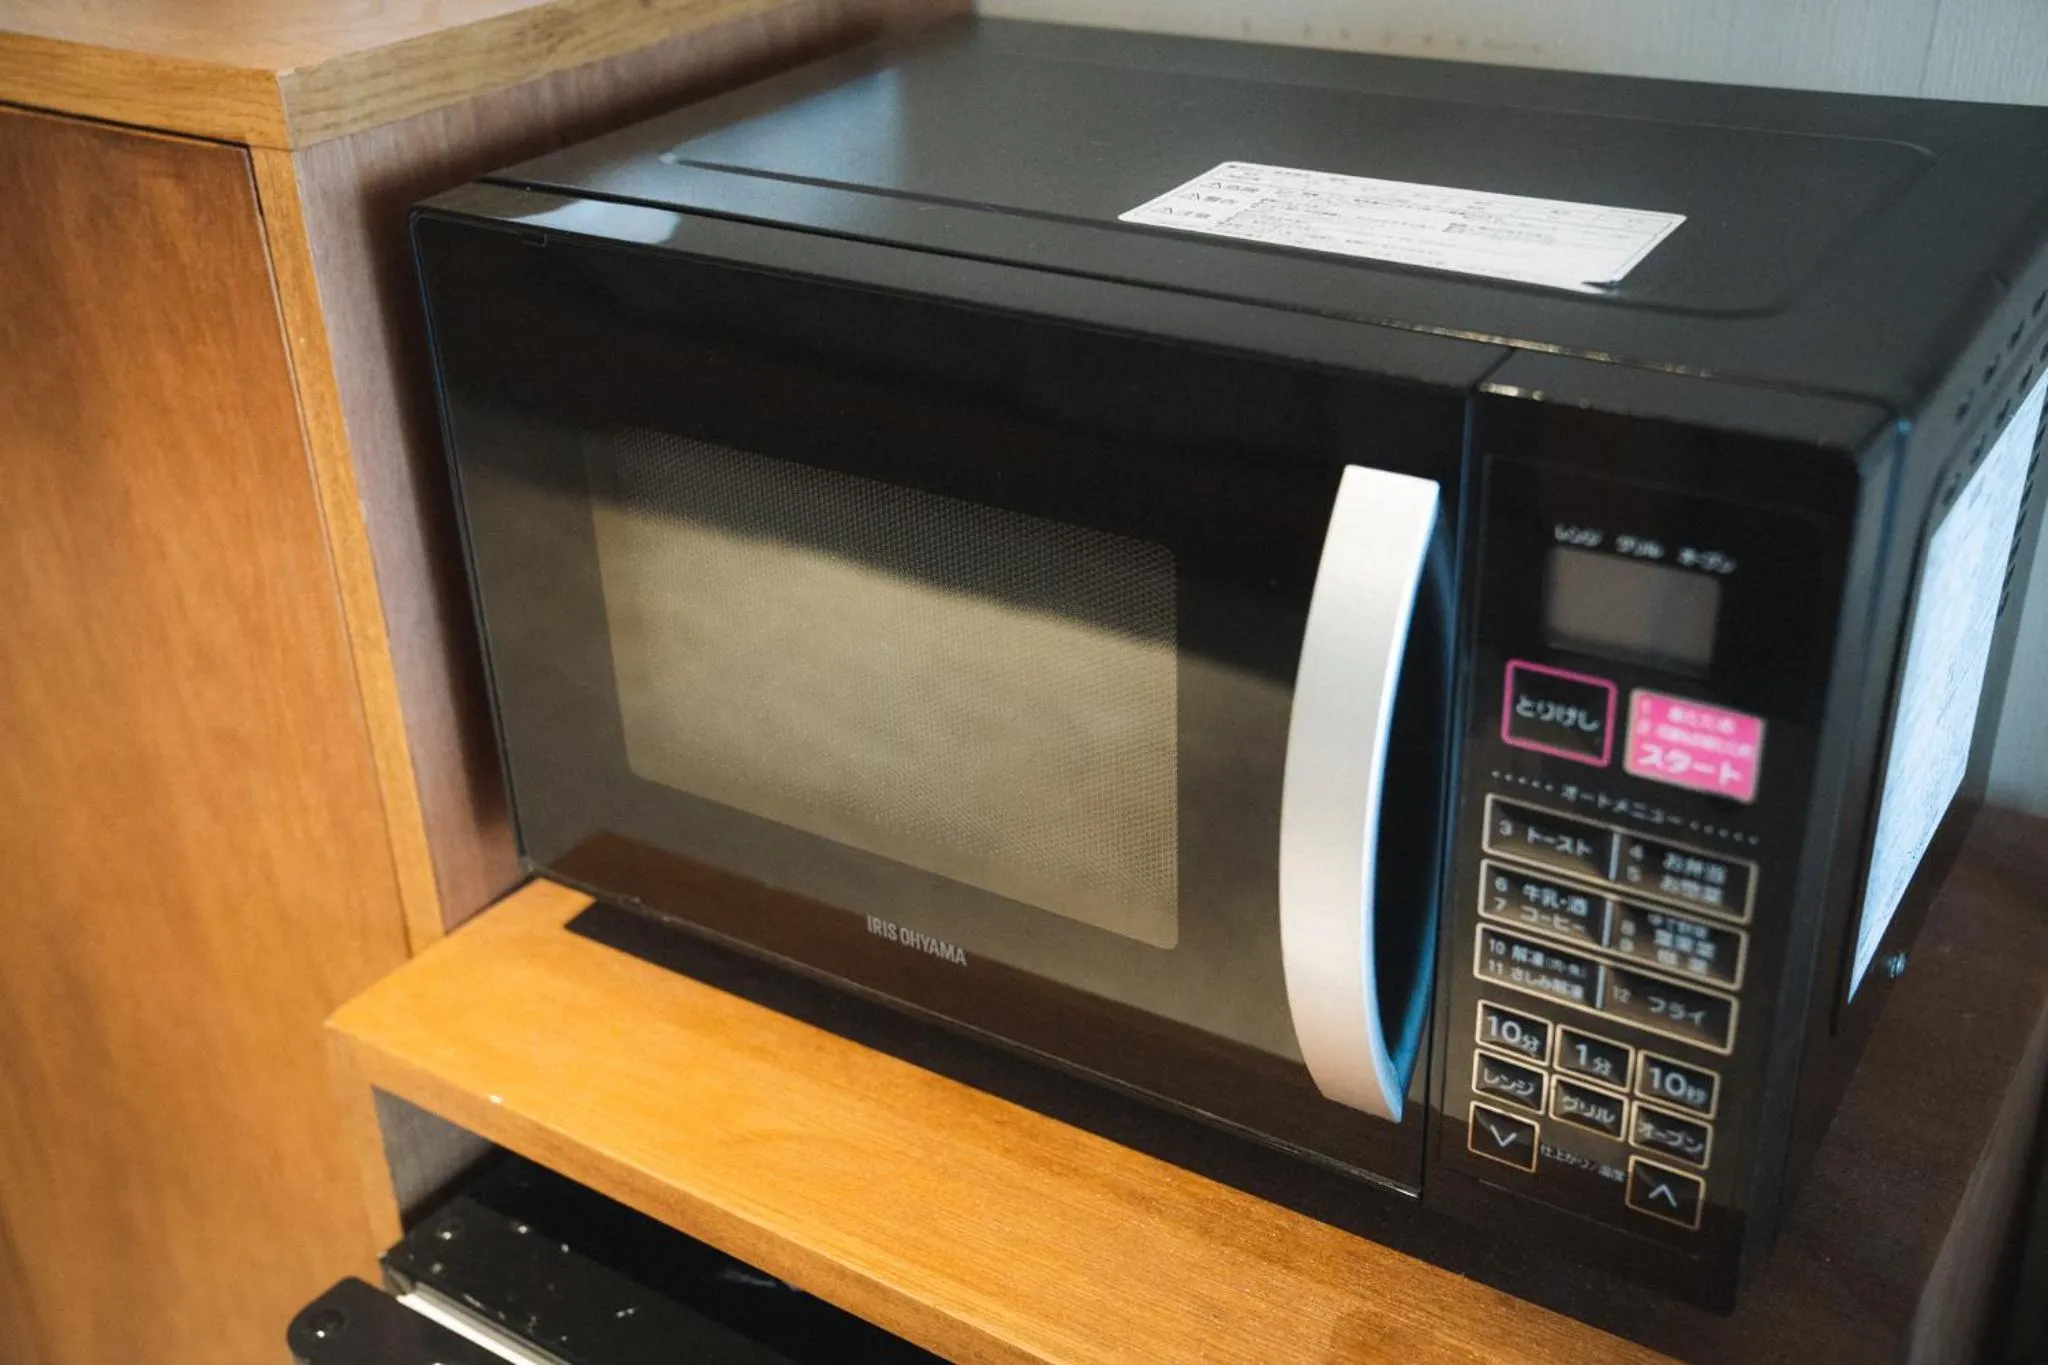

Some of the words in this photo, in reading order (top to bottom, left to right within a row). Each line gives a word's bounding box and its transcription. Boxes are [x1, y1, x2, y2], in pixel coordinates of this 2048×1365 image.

[1515, 694, 1600, 732] とりけし
[1635, 743, 1743, 786] スタート
[1560, 784, 1684, 826] オートメニュー
[1498, 819, 1513, 837] 3
[1526, 825, 1593, 857] トースト
[1494, 876, 1509, 893] 6
[1493, 897, 1508, 912] 7
[1519, 905, 1586, 934] コーヒー
[867, 915, 898, 941] IRIS
[900, 927, 967, 967] OHYAMA
[1487, 938, 1506, 956] 10
[1488, 959, 1505, 976] 11
[1612, 985, 1632, 1003] 12
[1648, 996, 1708, 1027] フライ
[1487, 1015, 1541, 1055] 10分
[1483, 1066, 1535, 1096] レンジ
[1648, 1066, 1708, 1106] 10秒
[1562, 1095, 1616, 1125] グリル
[1637, 1121, 1705, 1154] オーブン
